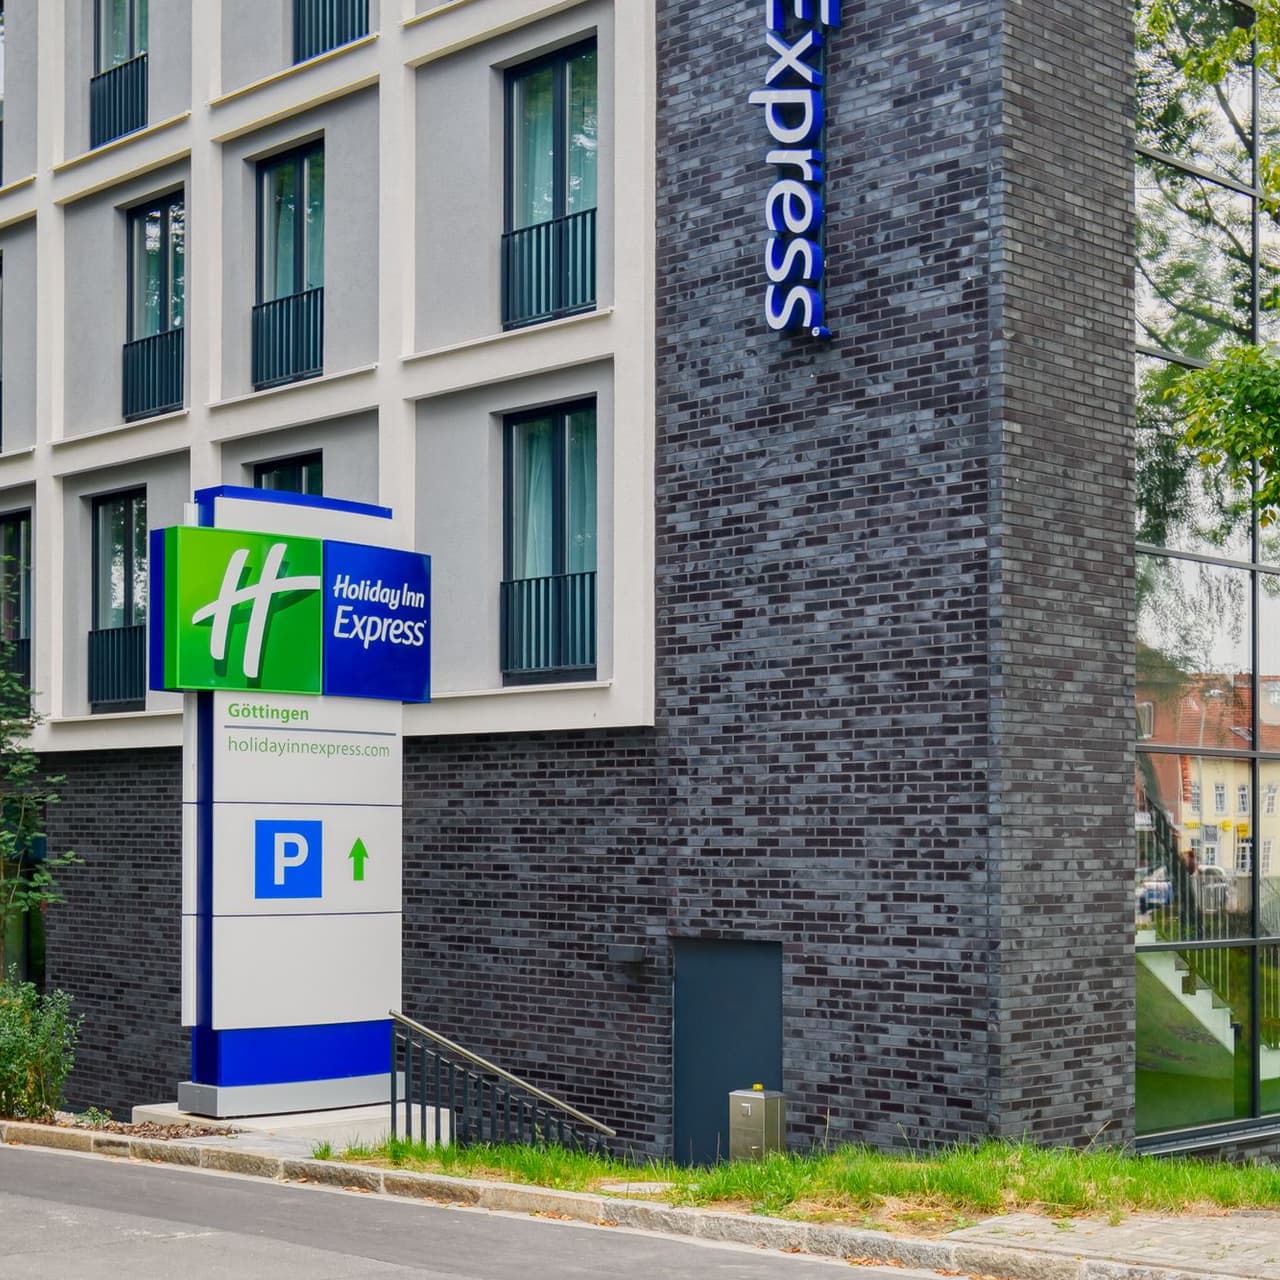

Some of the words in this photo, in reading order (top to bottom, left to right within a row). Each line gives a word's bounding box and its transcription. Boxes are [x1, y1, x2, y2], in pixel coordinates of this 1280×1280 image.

[333, 574, 401, 610] Holiday
[402, 583, 425, 608] Inn
[333, 605, 425, 649] Express
[228, 703, 309, 723] Göttingen
[228, 736, 390, 758] holidayinnexpress.com
[274, 832, 309, 885] P
